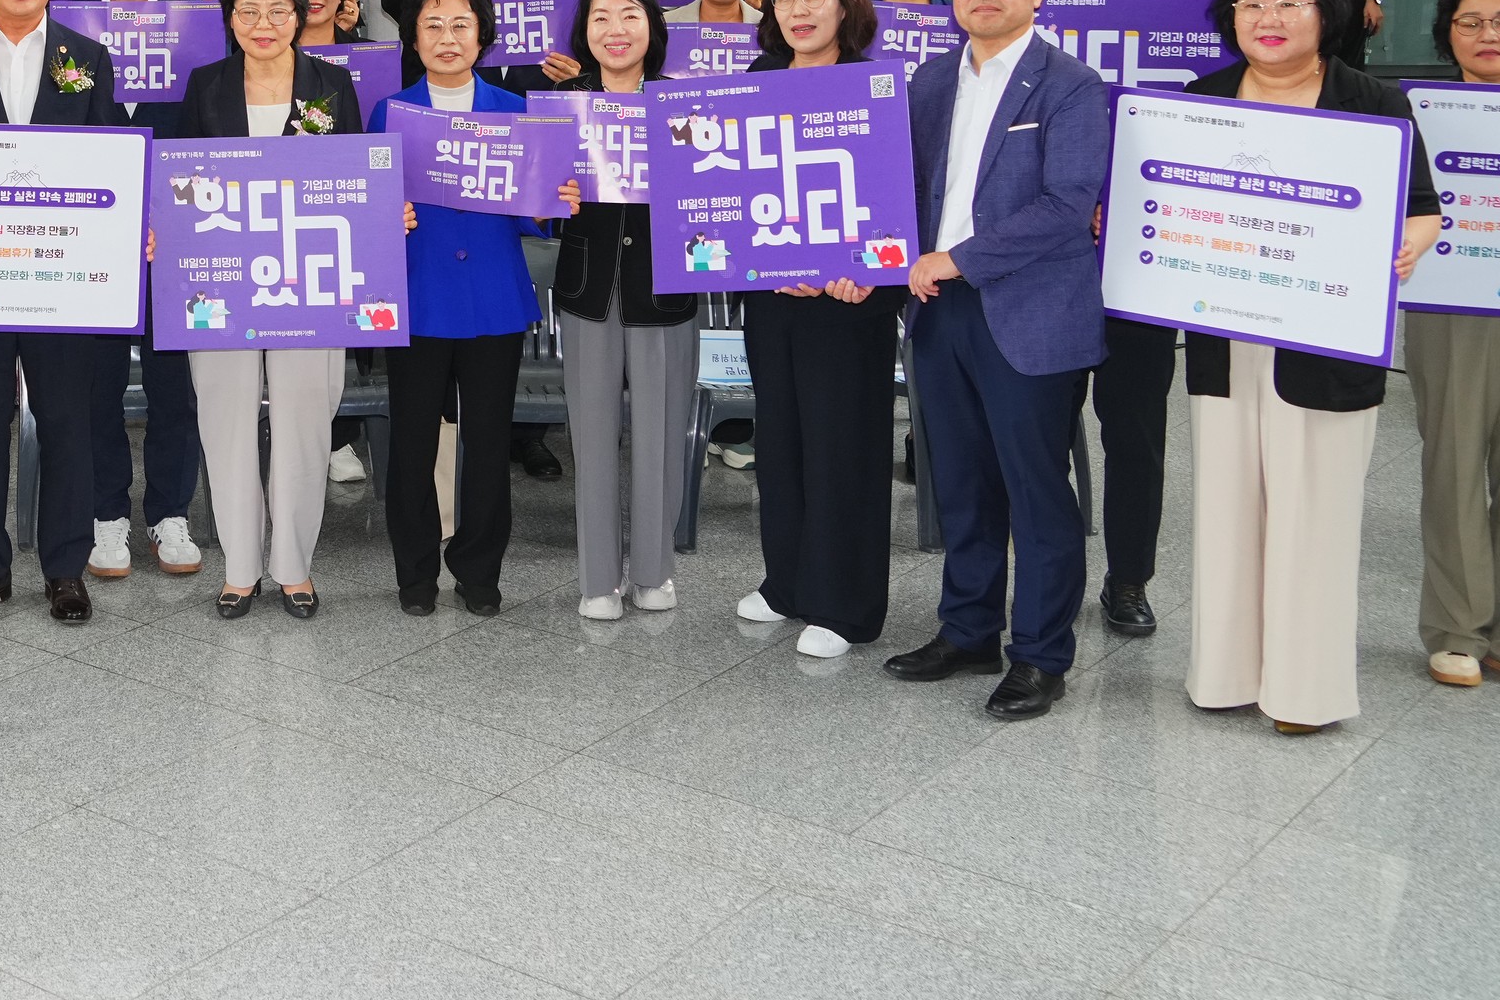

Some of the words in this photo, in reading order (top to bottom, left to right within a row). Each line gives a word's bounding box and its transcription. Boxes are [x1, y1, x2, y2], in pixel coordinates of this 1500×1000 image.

[1148, 32, 1184, 43] 기업과
[1186, 32, 1222, 44] 여성을
[1148, 45, 1182, 57] 여성의
[1185, 45, 1221, 58] 경력을
[124, 65, 177, 89] 있다
[706, 86, 759, 97] 전남광주통합특별시
[802, 112, 834, 124] 기업과
[836, 109, 869, 121] 여성을
[1184, 114, 1244, 128] 전남광주통합특별시
[803, 127, 835, 139] 여성의
[837, 124, 870, 136] 경력을
[692, 114, 796, 173] 잇다
[436, 139, 488, 166] 잇다
[303, 181, 333, 191] 기업과
[336, 179, 367, 190] 여성을
[460, 174, 518, 202] 있다
[1161, 166, 1236, 188] 경력단절예방
[1239, 175, 1265, 192] 실천
[1268, 179, 1295, 196] 약속
[1298, 184, 1339, 202] 캠페인
[15, 191, 35, 202] 실천
[39, 192, 61, 203] 약속
[64, 192, 97, 203] 캠페인
[303, 194, 333, 204] 여성의
[336, 193, 367, 204] 경력을
[678, 198, 708, 210] 내일의
[711, 196, 741, 209] 희망이
[194, 180, 297, 233] 잇다
[688, 212, 708, 224] 나의
[711, 210, 742, 222] 성장이
[750, 188, 870, 247] 있다
[6, 225, 46, 235] 직장환경
[49, 226, 78, 237] 만들기
[1228, 214, 1275, 232] 직장환경
[1278, 222, 1314, 238] 만들기
[34, 248, 64, 259] 활성화
[1259, 244, 1295, 262] 활성화
[179, 258, 209, 269] 내일의
[212, 257, 242, 268] 희망이
[66, 272, 85, 282] 기회
[89, 272, 108, 282] 보장
[189, 272, 209, 282] 나의
[212, 270, 242, 281] 성장이
[250, 253, 364, 307] 있다
[1157, 255, 1202, 273] 차별없는
[1296, 277, 1320, 293] 기회
[1324, 282, 1349, 297] 보장
